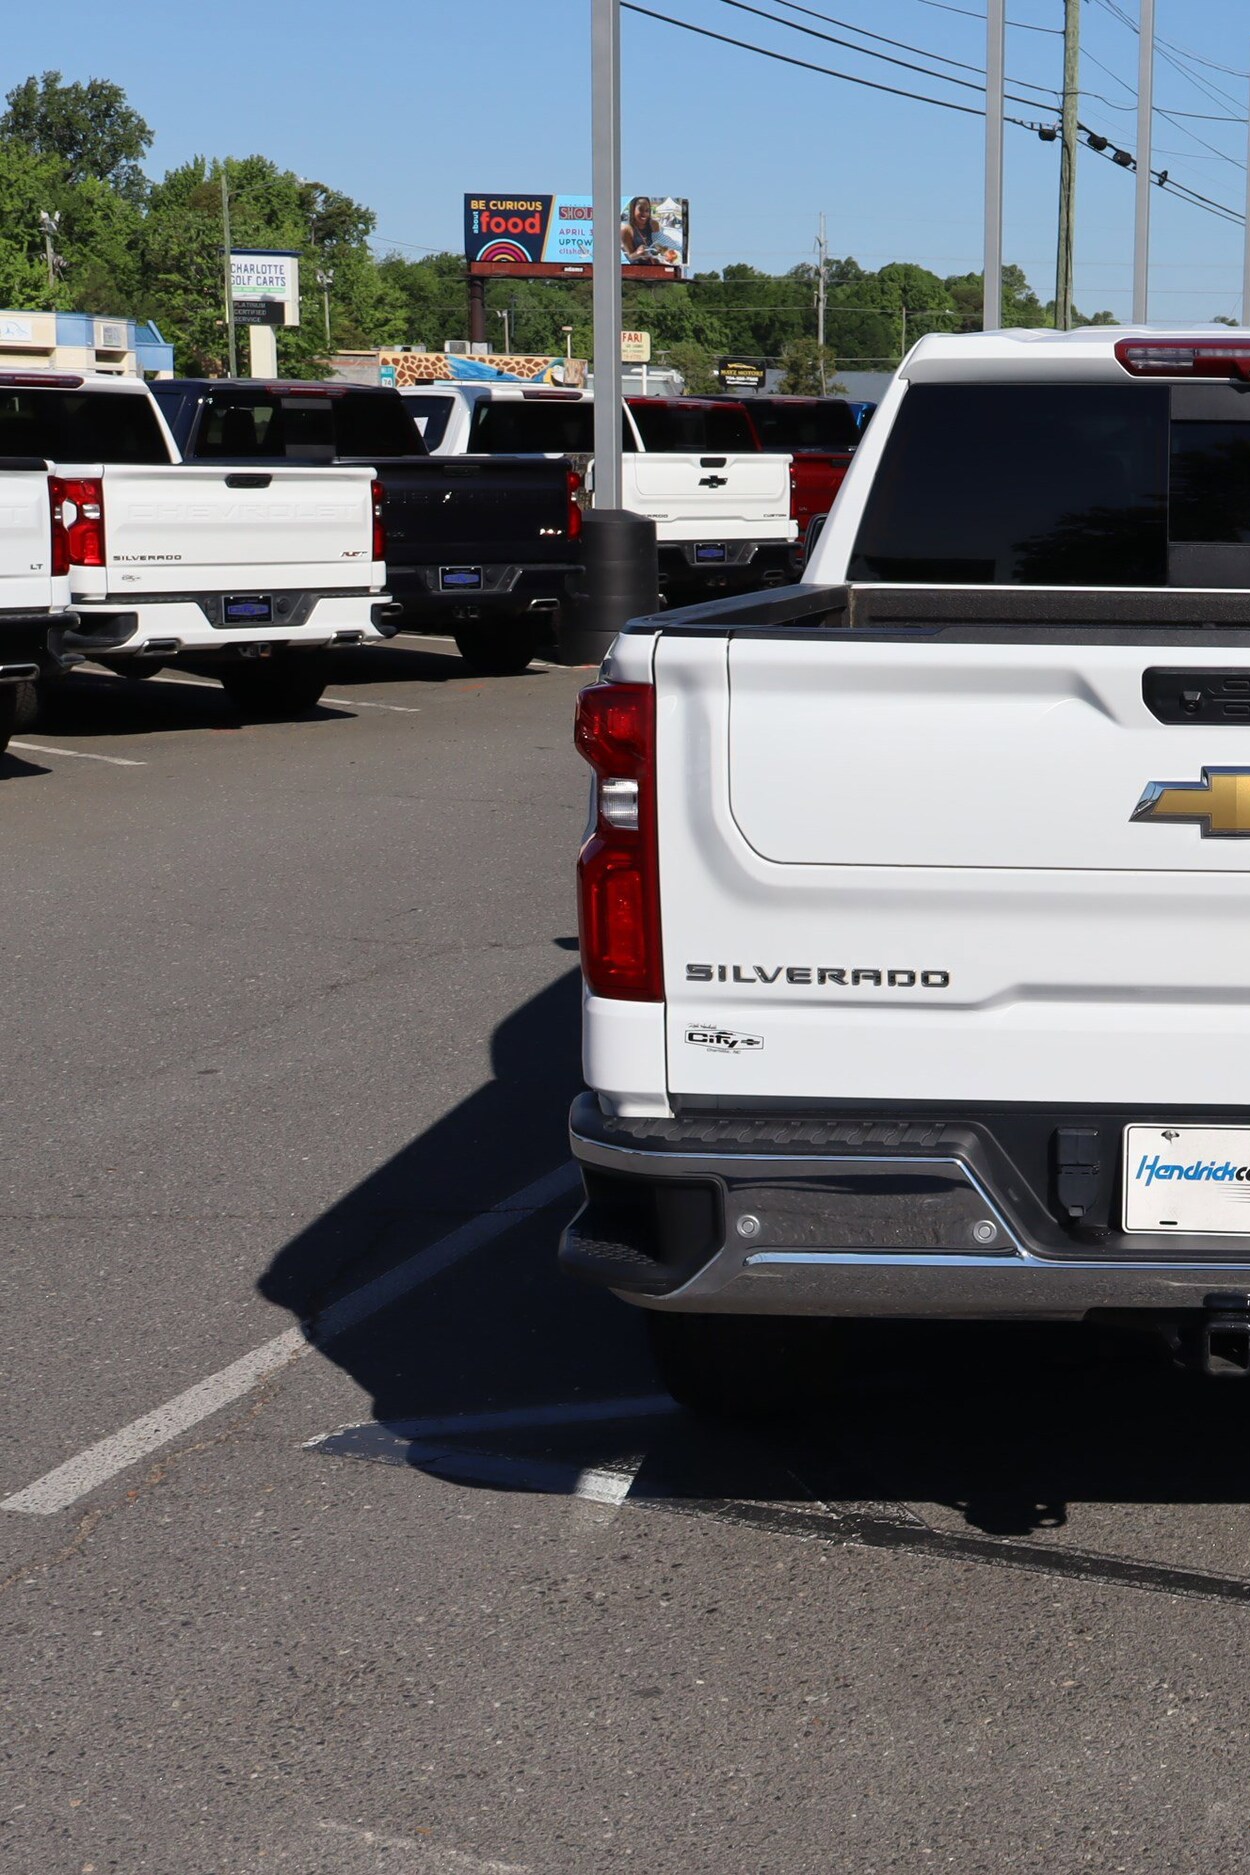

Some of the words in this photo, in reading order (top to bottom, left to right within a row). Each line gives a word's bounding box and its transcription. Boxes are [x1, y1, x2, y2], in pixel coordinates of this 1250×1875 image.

[470, 200, 487, 210] BE
[489, 201, 543, 211] CURIOUS
[560, 207, 593, 220] SHOU
[472, 211, 480, 234] about
[480, 211, 541, 234] food
[558, 238, 593, 246] UPTOW
[231, 263, 285, 275] CHARLOTTE
[231, 275, 253, 286] GOLF
[255, 275, 287, 287] CARTS
[622, 332, 643, 343] FARI
[127, 503, 358, 521] CHEVROLET
[112, 554, 183, 562] SILVERADO
[685, 963, 950, 989] SILVERADO
[687, 1031, 739, 1049] City
